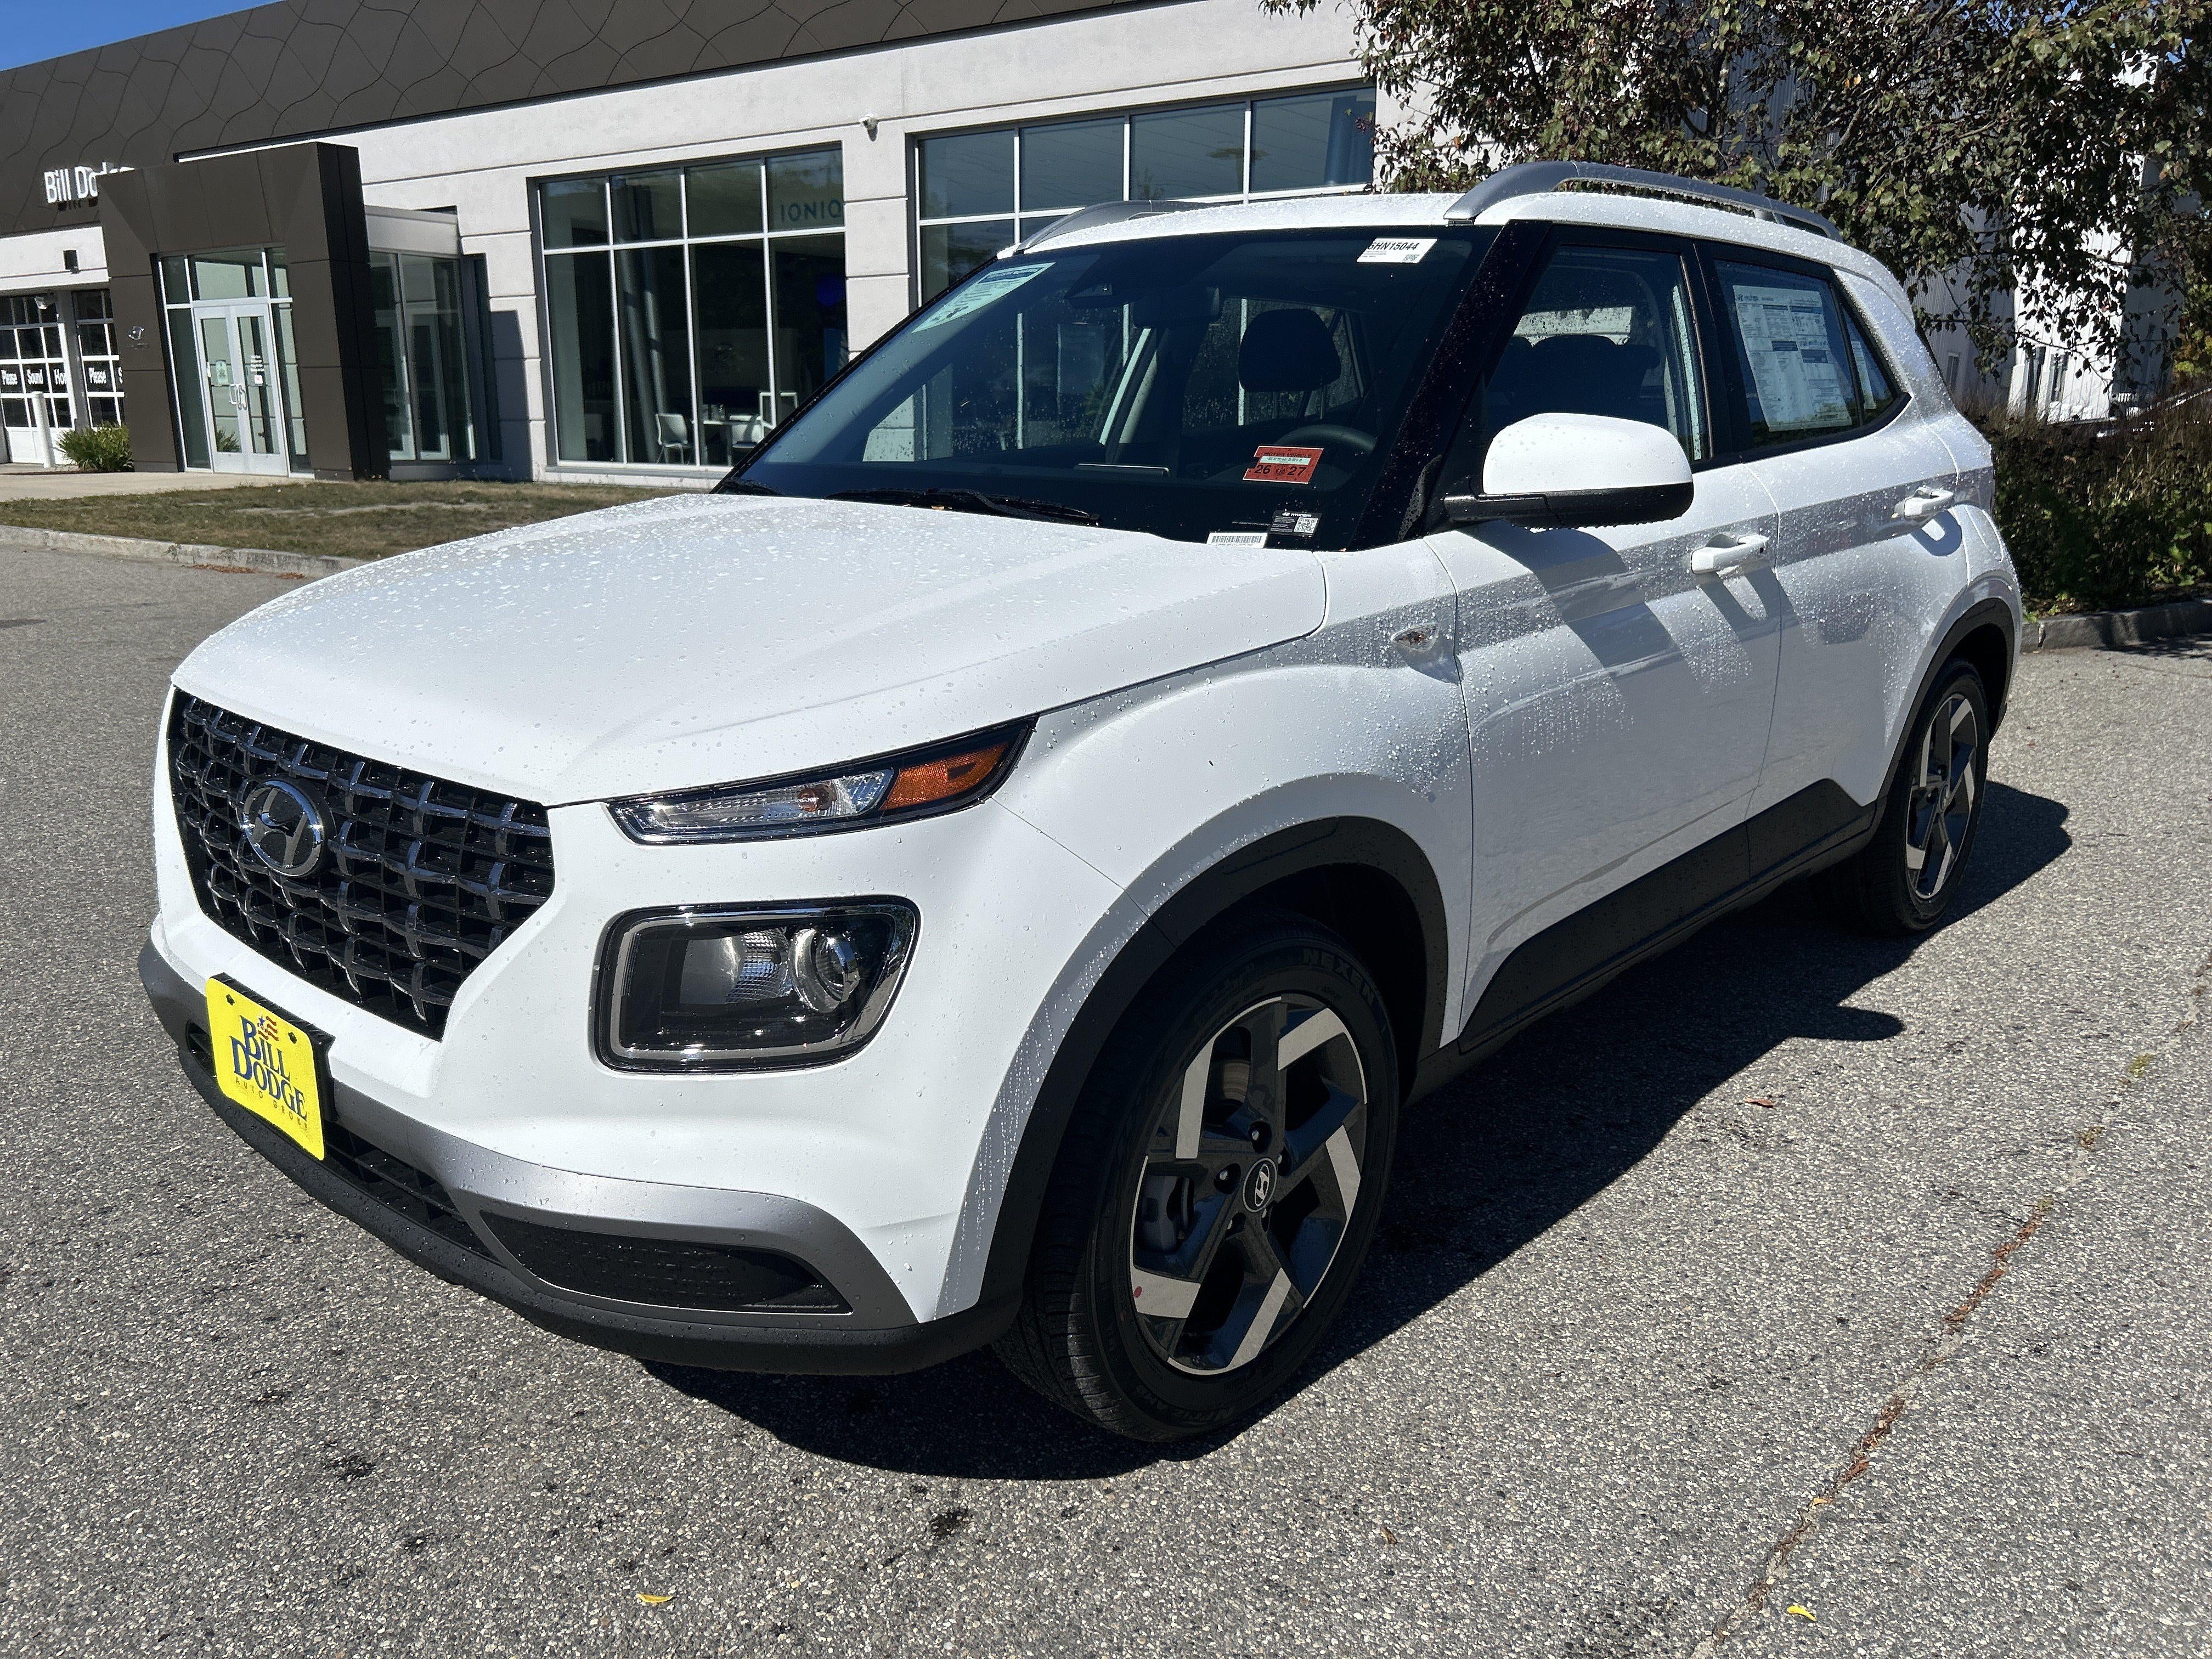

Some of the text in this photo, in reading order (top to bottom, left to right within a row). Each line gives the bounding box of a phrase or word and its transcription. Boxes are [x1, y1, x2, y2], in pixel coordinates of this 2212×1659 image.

[44, 167, 72, 204] Bill
[1, 370, 18, 385] Please
[26, 369, 44, 385] Sound
[88, 367, 107, 384] Please
[1254, 464, 1272, 475] 26
[1287, 466, 1307, 476] 27
[1302, 947, 1374, 1007] NEXEN
[240, 1015, 291, 1082] BILL
[229, 1035, 308, 1121] DODGE
[235, 1076, 308, 1131] AUTO GROUP
